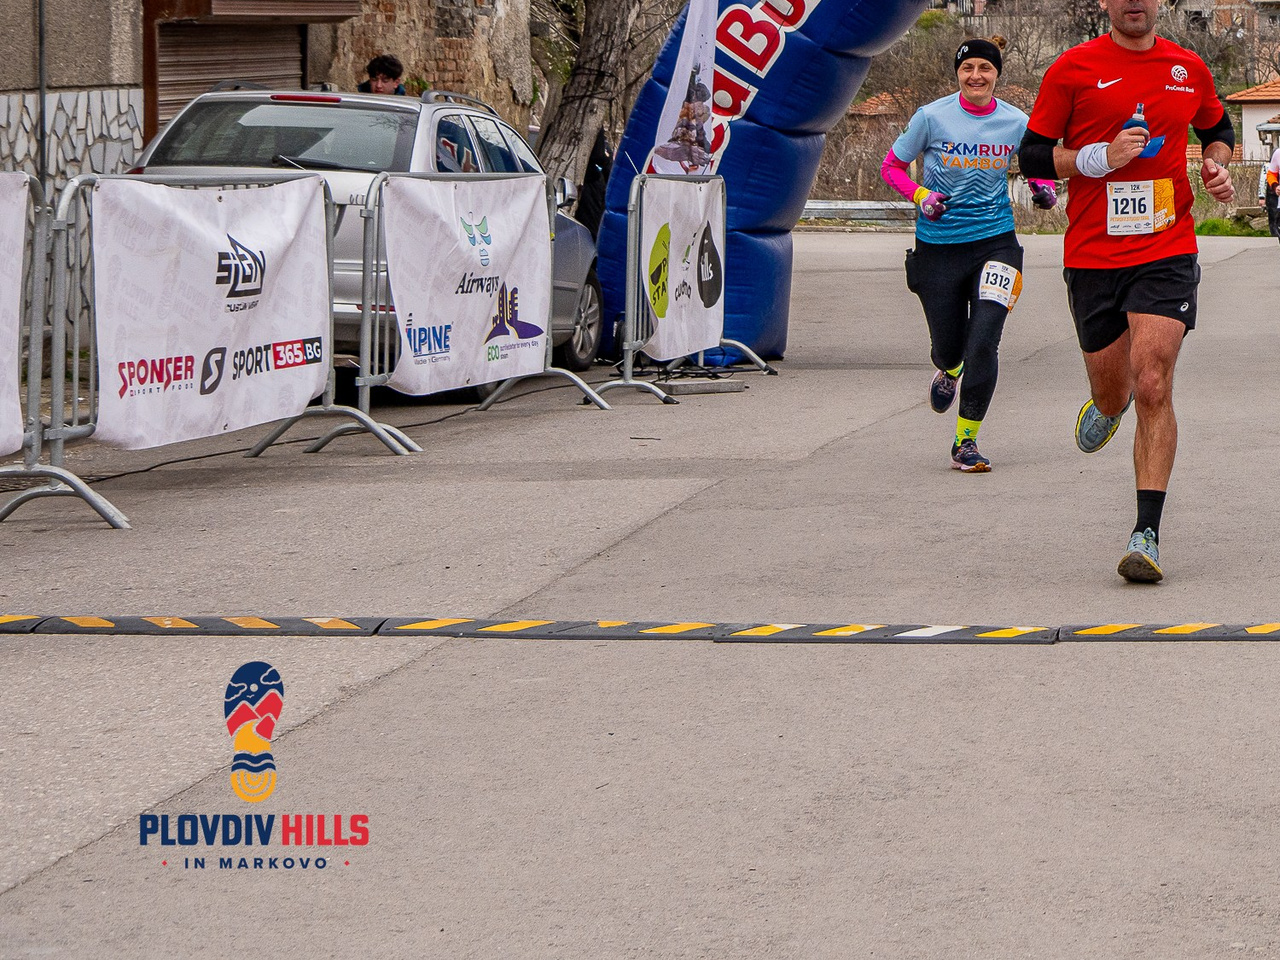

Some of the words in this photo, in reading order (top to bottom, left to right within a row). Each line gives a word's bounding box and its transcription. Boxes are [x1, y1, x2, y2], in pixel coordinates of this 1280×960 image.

[1112, 197, 1147, 215] 1216
[455, 272, 500, 298] Airways
[985, 271, 1011, 290] 1312
[118, 355, 195, 399] SPONSER
